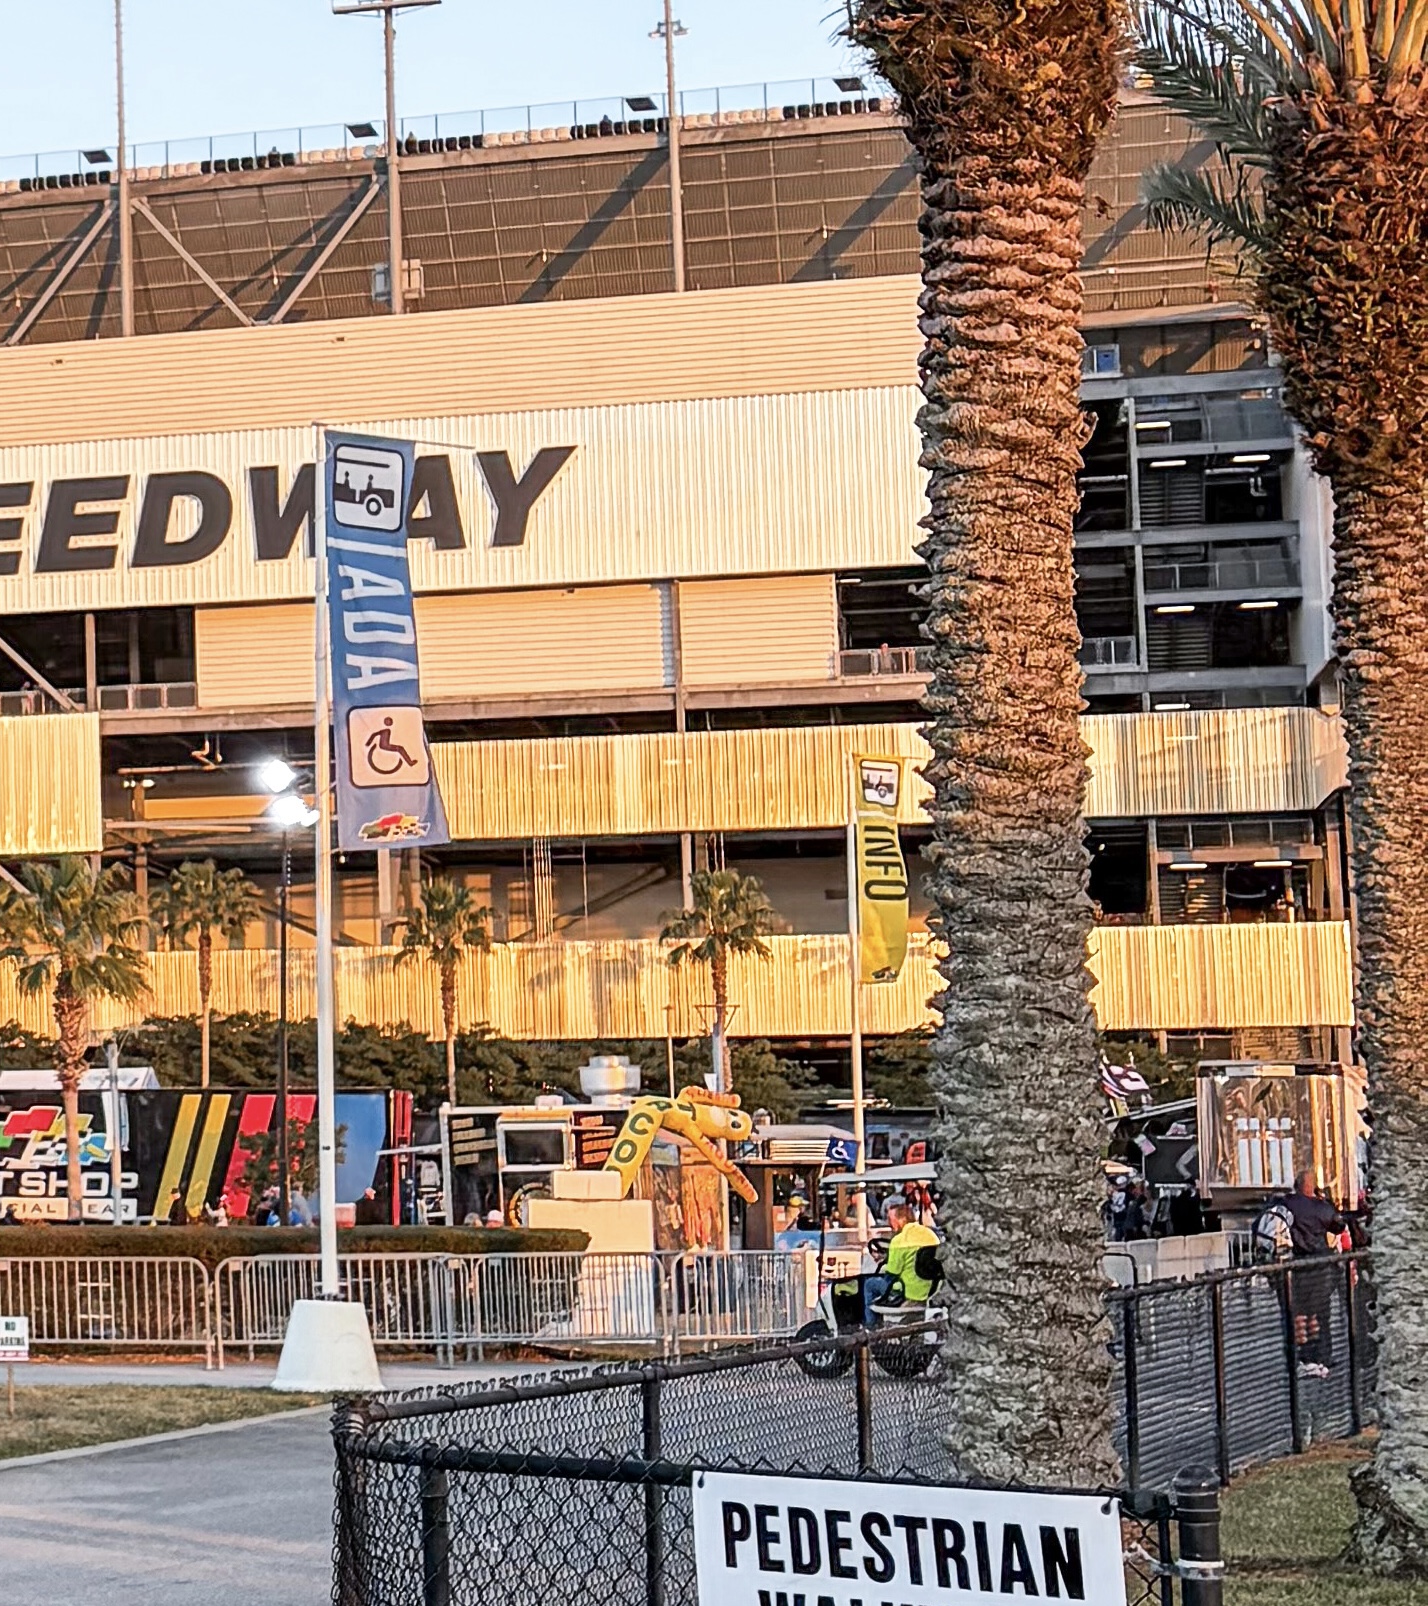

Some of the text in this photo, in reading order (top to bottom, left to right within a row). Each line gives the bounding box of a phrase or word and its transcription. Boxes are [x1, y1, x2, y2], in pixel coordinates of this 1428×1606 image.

[338, 564, 418, 691] ADA
[864, 825, 908, 901] INFO
[19, 1171, 139, 1197] SHOP
[88, 1202, 130, 1214] EAR
[5, 1321, 16, 1331] NO
[722, 1501, 1085, 1600] PEDESTRIAN
